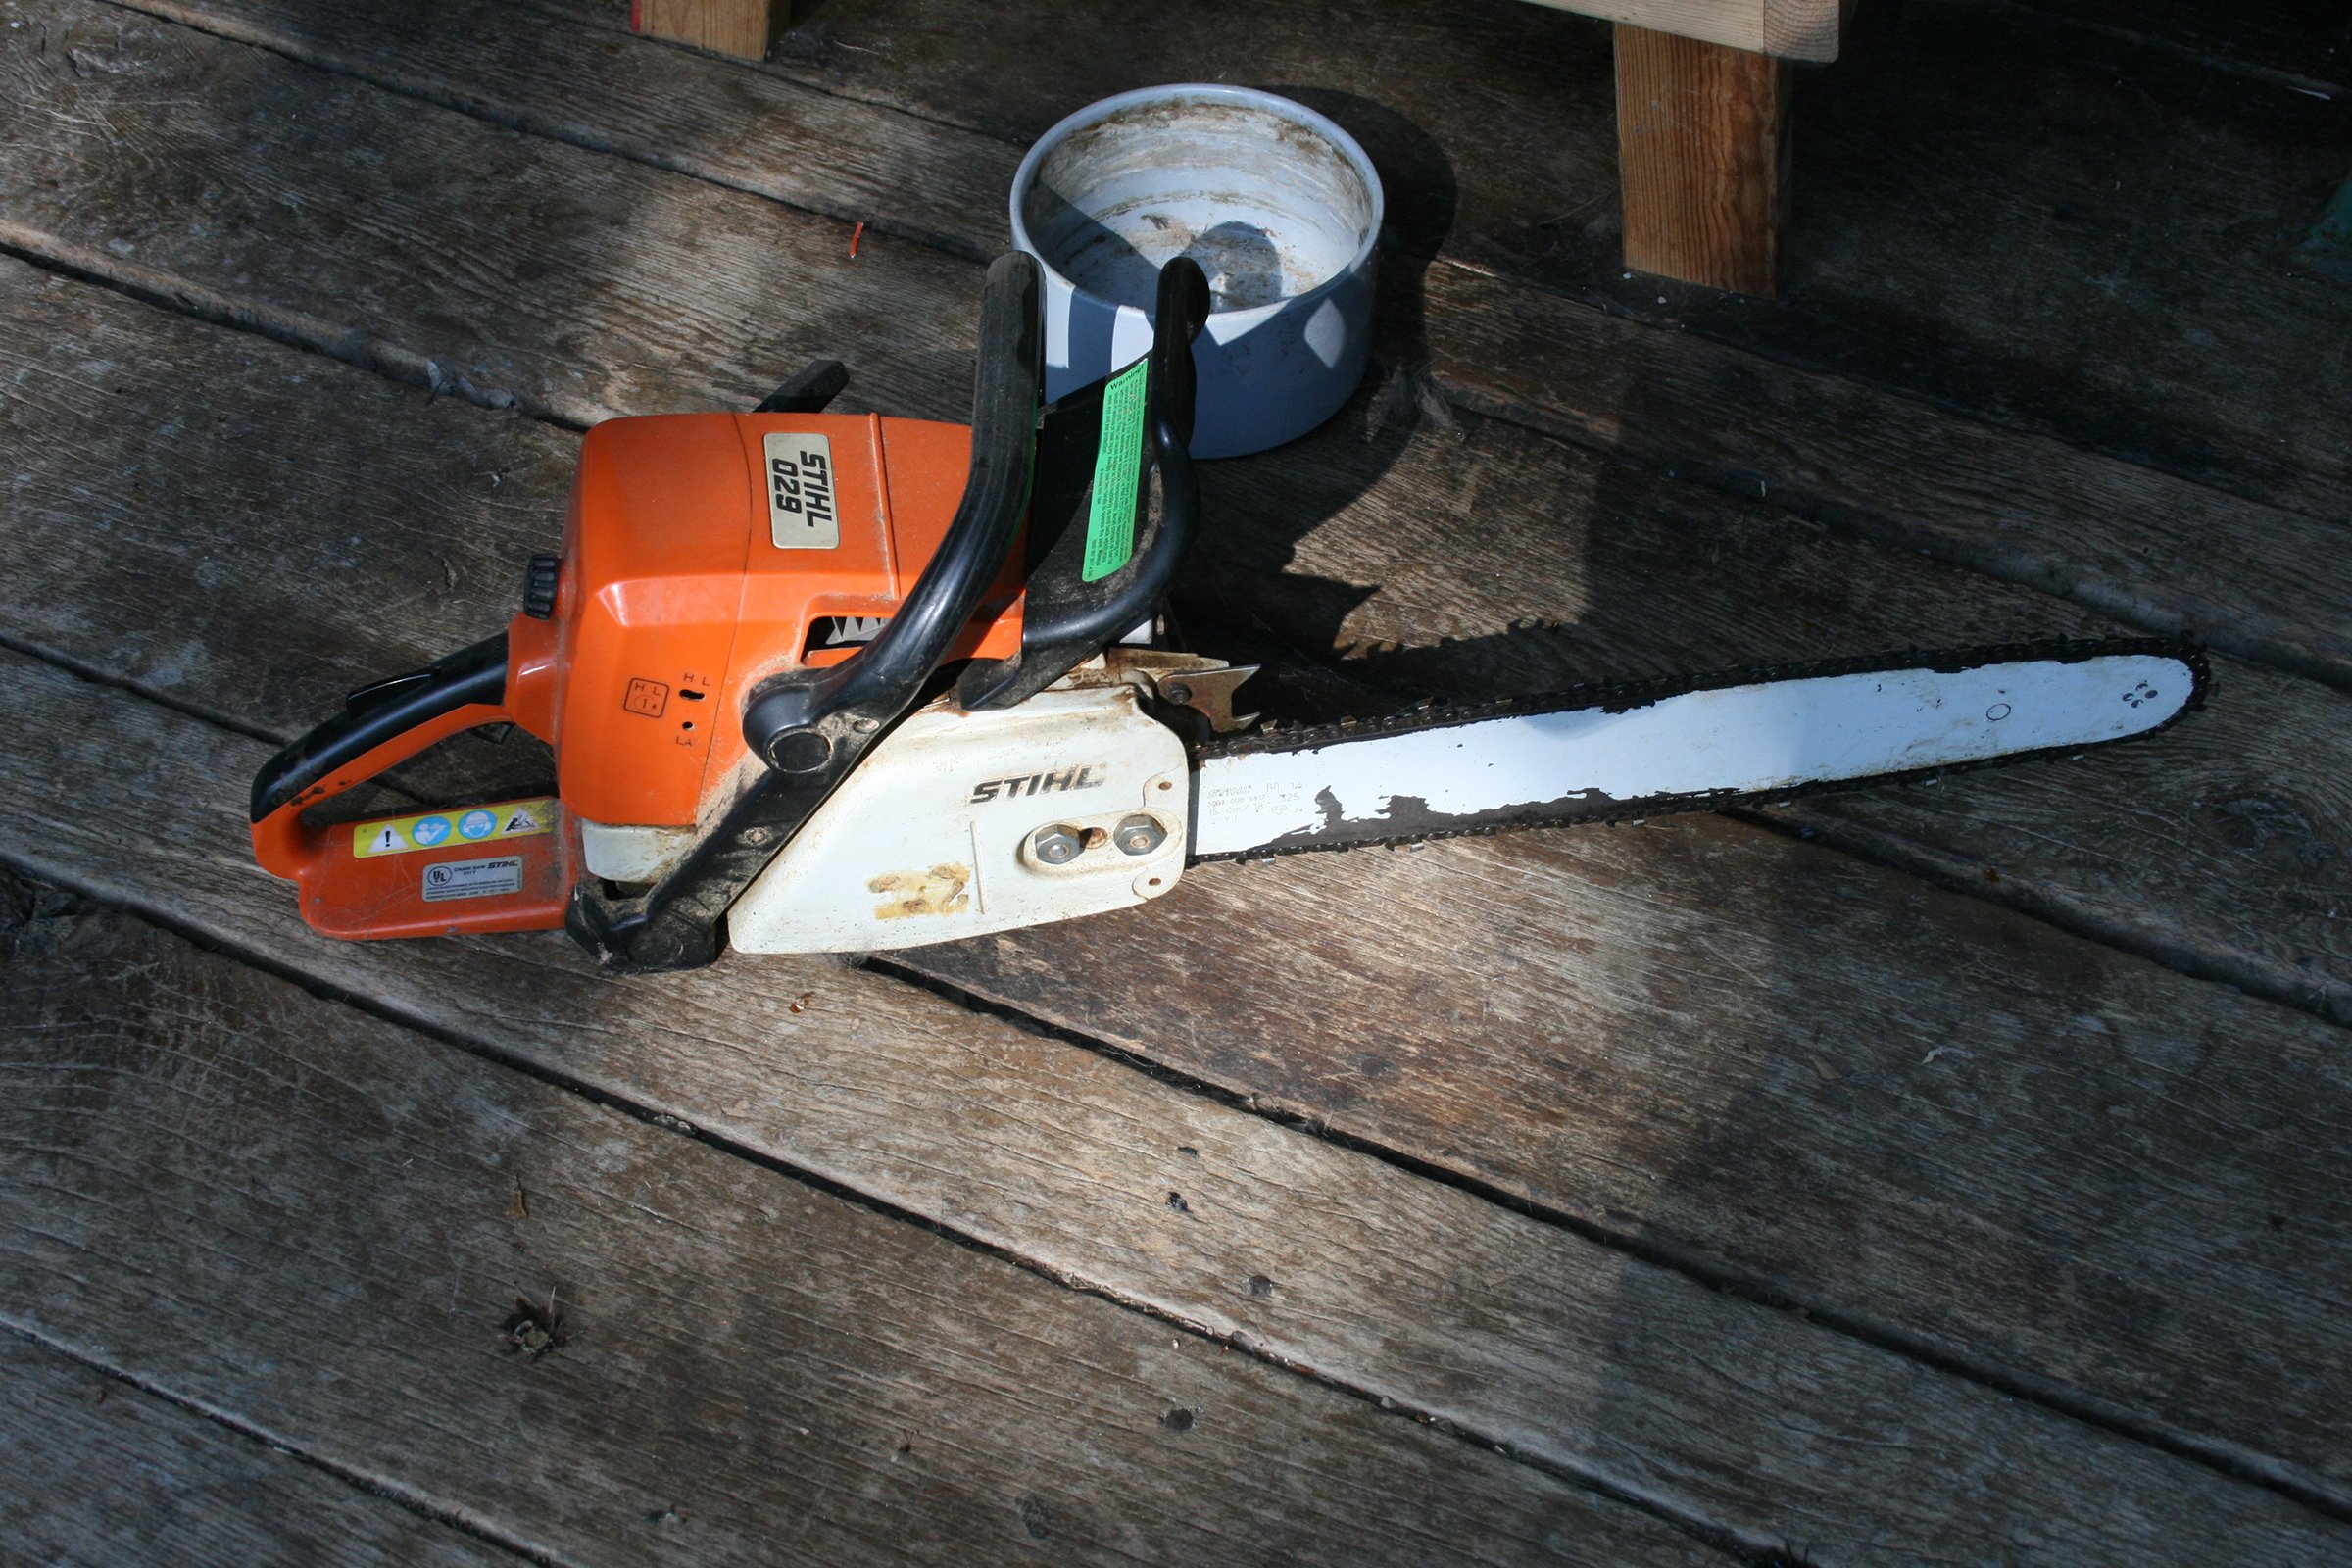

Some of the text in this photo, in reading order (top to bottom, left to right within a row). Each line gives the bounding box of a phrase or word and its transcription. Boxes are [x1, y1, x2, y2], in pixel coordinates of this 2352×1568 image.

[772, 458, 802, 514] 029
[800, 450, 832, 527] STIHL
[634, 682, 662, 696] H L
[683, 672, 710, 686] H L
[970, 765, 1104, 804] STIHL
[488, 860, 518, 869] STIHL
